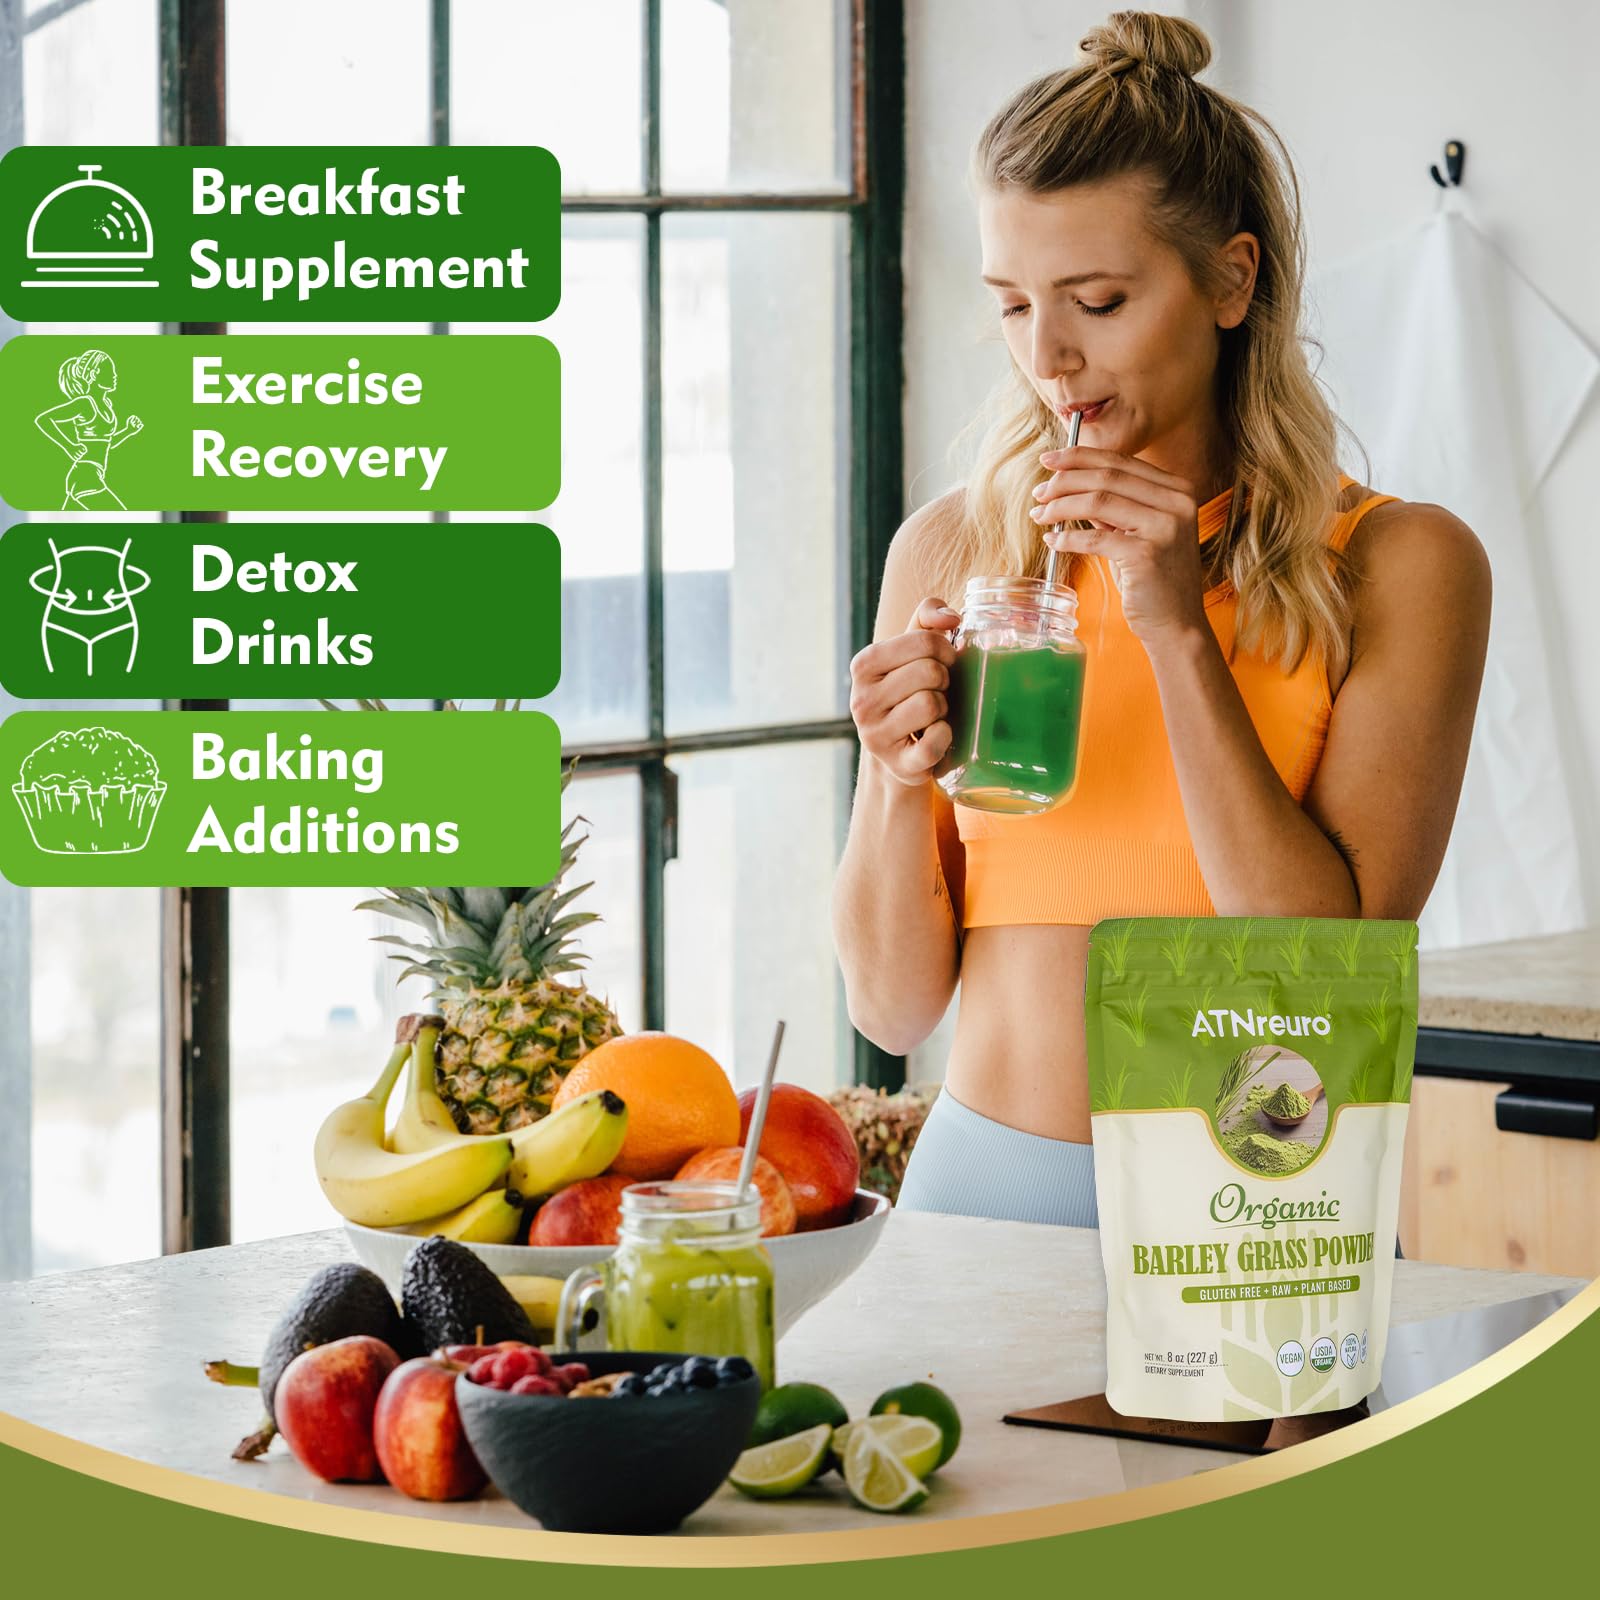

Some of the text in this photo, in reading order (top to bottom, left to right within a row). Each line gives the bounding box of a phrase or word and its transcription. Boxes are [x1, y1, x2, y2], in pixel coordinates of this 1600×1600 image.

[1209, 1183, 1340, 1229] Organic
[1132, 1243, 1229, 1276] BARLEY
[1237, 1238, 1307, 1272] GRASS
[1200, 1288, 1237, 1301] GLUTEN
[1240, 1286, 1261, 1298] FREE
[1272, 1284, 1291, 1296] RAW
[1301, 1281, 1326, 1294] PLANT
[1328, 1279, 1351, 1292] BASED
[1315, 1345, 1333, 1357] USDA
[1144, 1353, 1154, 1361] NET
[1167, 1352, 1173, 1363] 8
[1175, 1355, 1184, 1363] oz
[1187, 1352, 1207, 1365] (227
[1209, 1352, 1218, 1365] g)
[1280, 1352, 1302, 1364] VEGAN
[1145, 1365, 1204, 1377] DIETARY SUPPLEMENT
